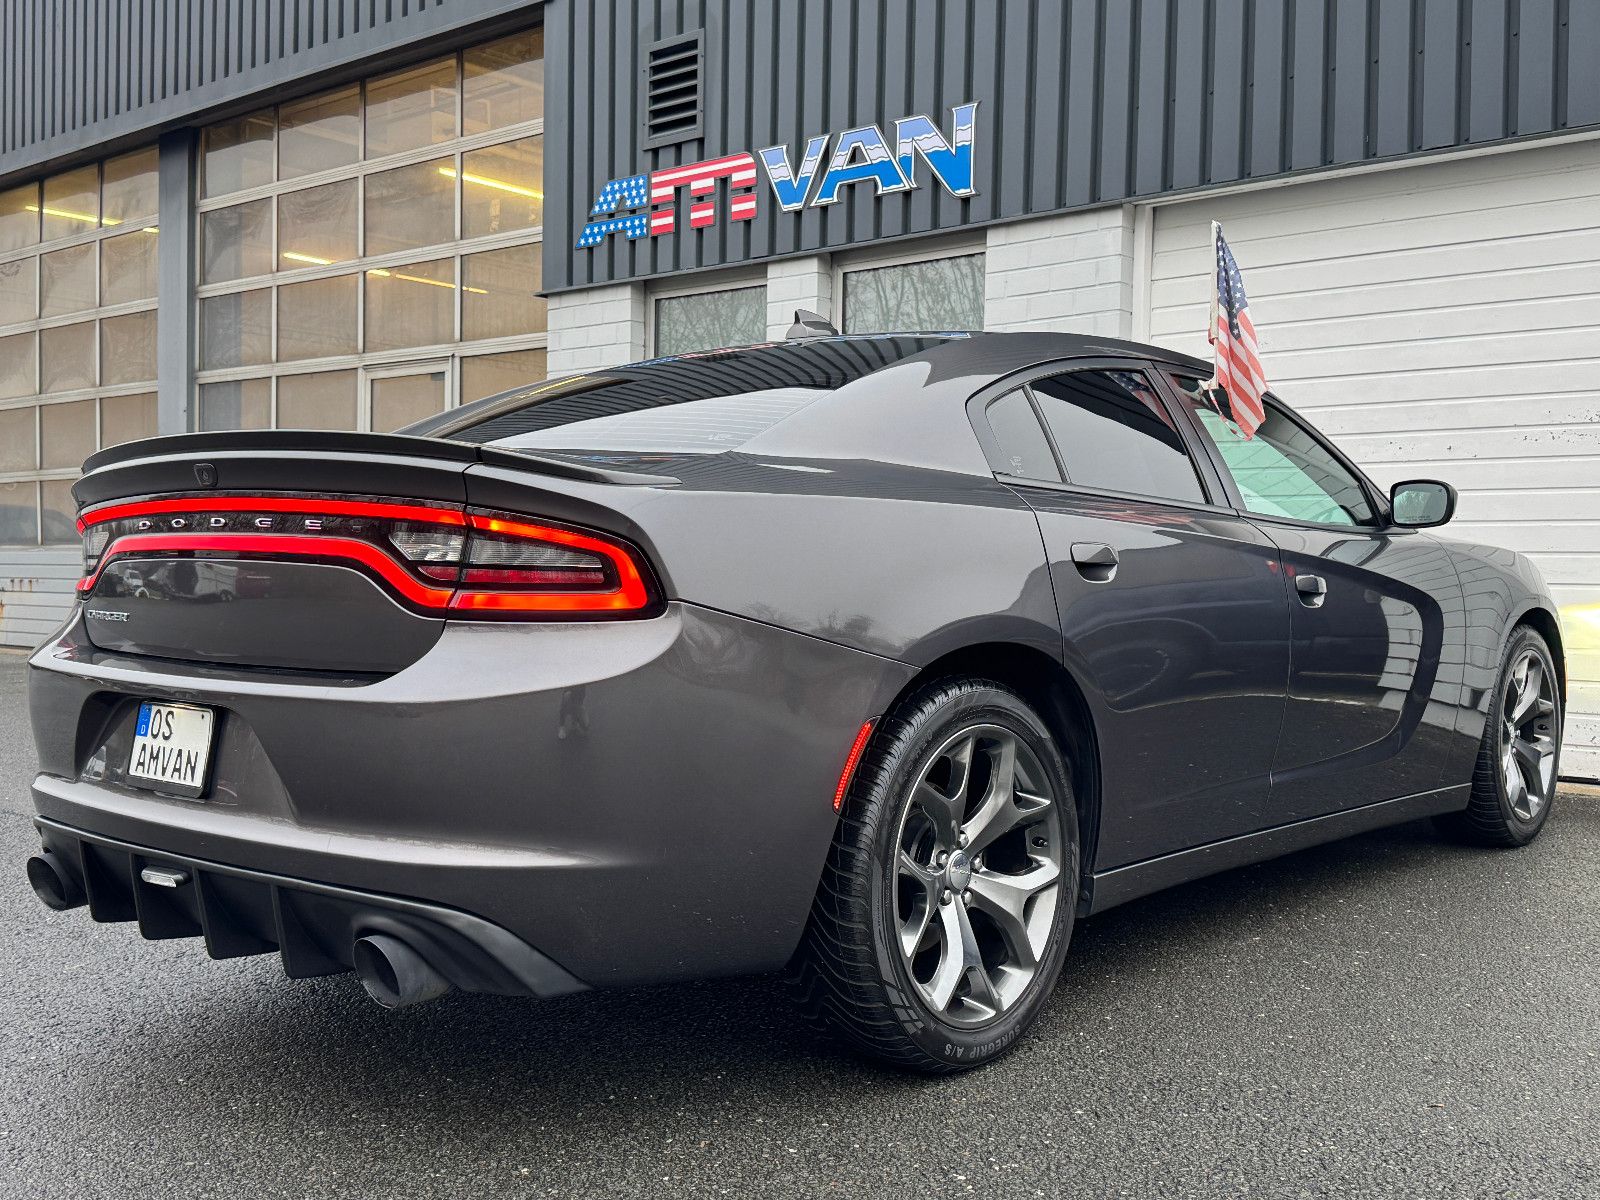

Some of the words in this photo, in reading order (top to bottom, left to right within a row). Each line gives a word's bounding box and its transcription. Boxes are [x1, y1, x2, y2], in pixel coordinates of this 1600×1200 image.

[138, 517, 323, 530] DODGE
[140, 724, 146, 735] D
[151, 708, 175, 741] OS
[135, 743, 198, 782] AMVAN
